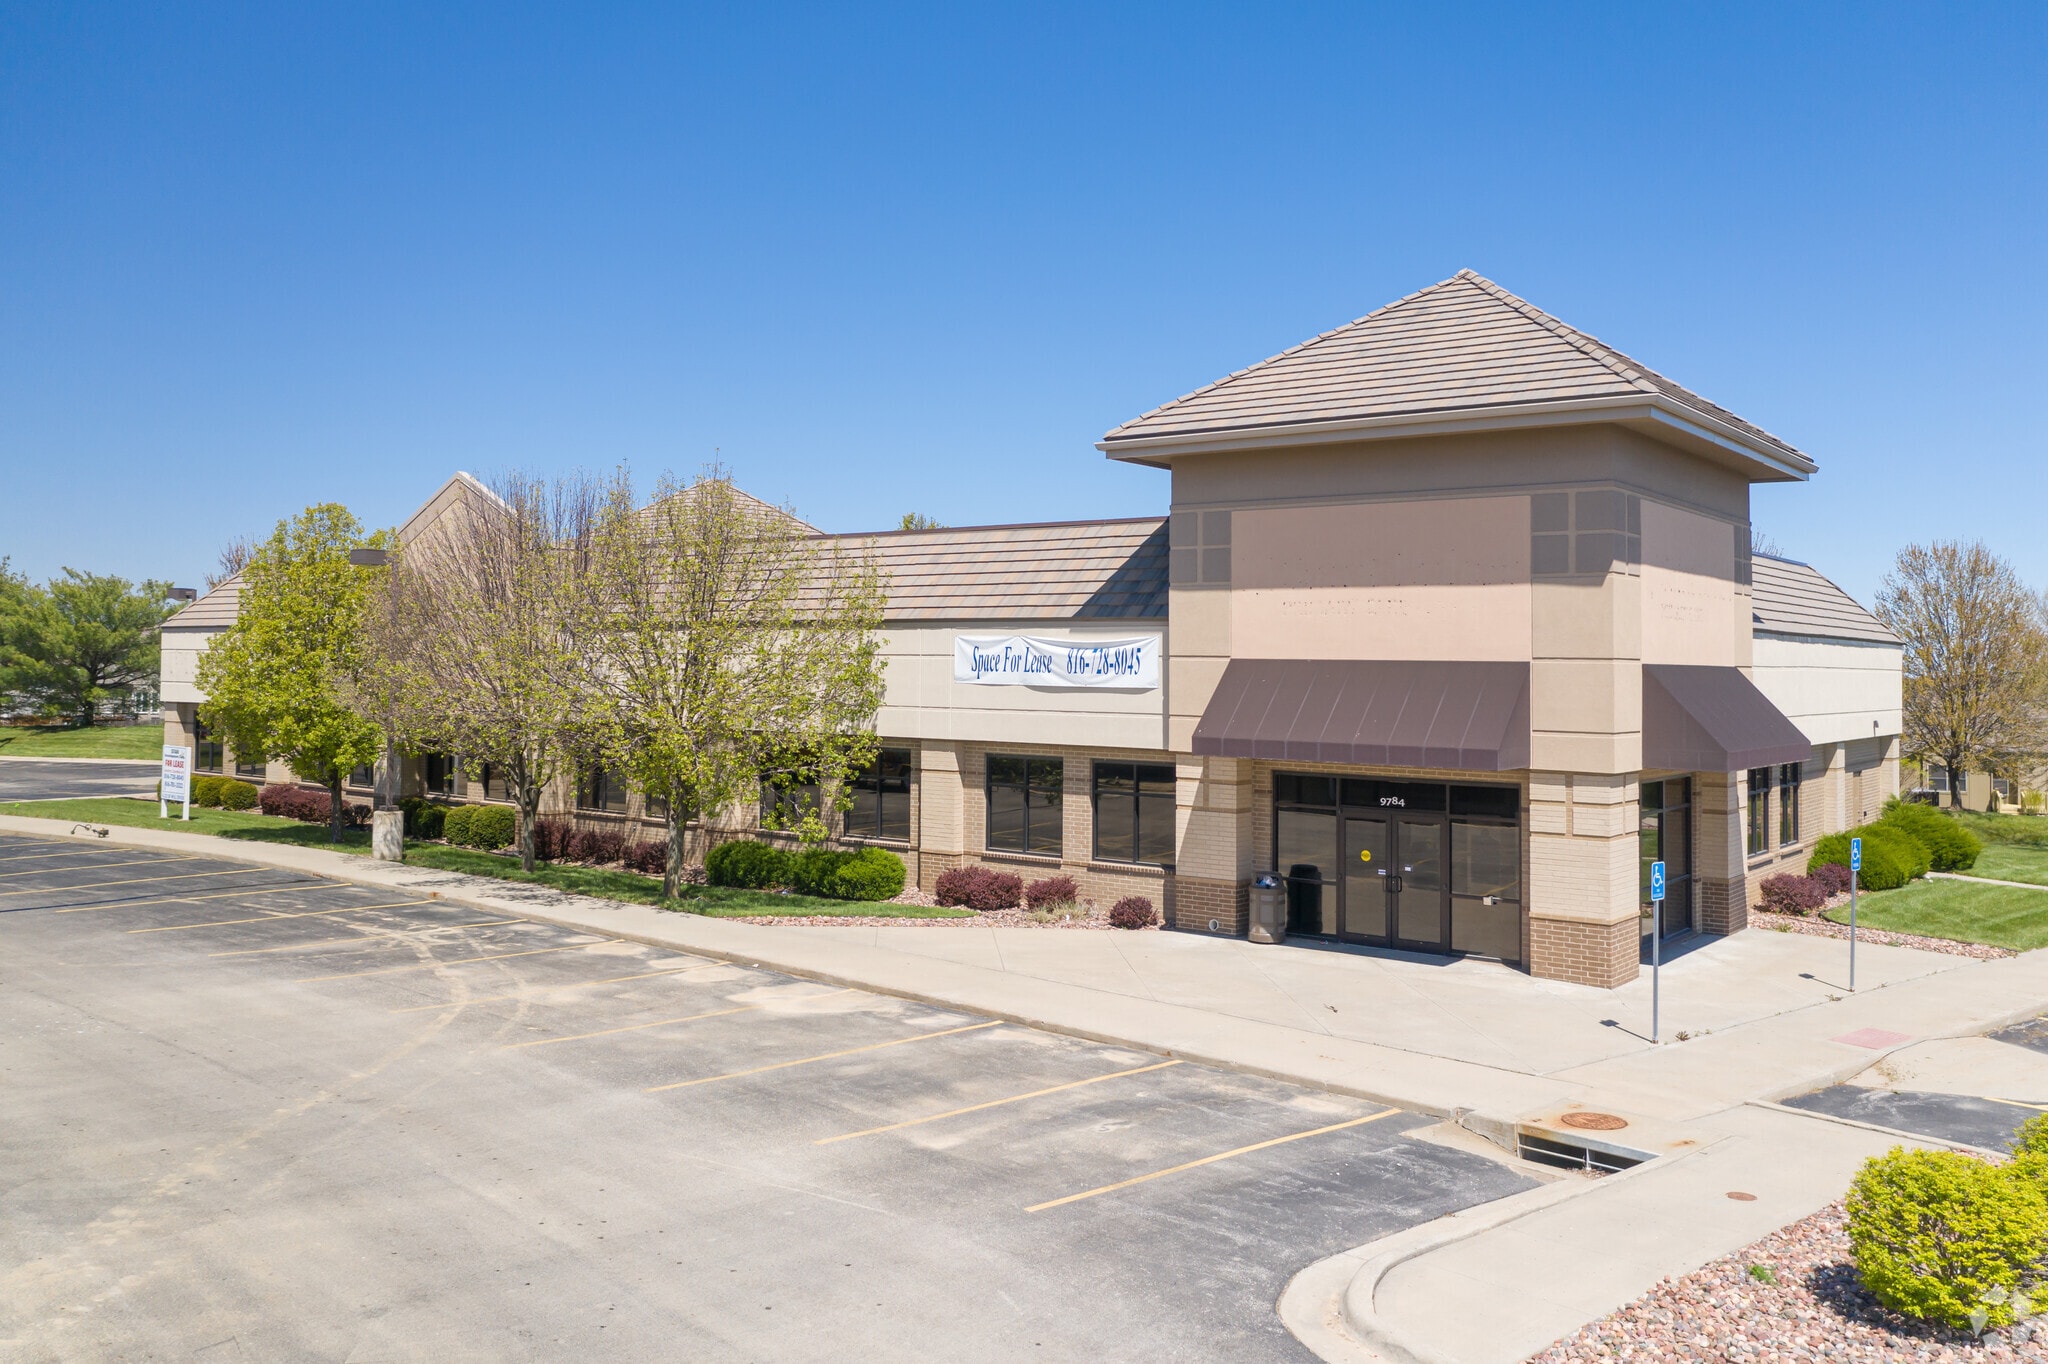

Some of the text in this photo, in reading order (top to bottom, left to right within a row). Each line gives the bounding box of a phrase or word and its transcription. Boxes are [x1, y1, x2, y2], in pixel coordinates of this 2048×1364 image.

[971, 646, 1142, 679] Space For Lease 816-728-8045
[173, 760, 184, 768] LEASE
[1380, 796, 1405, 807] 9784
